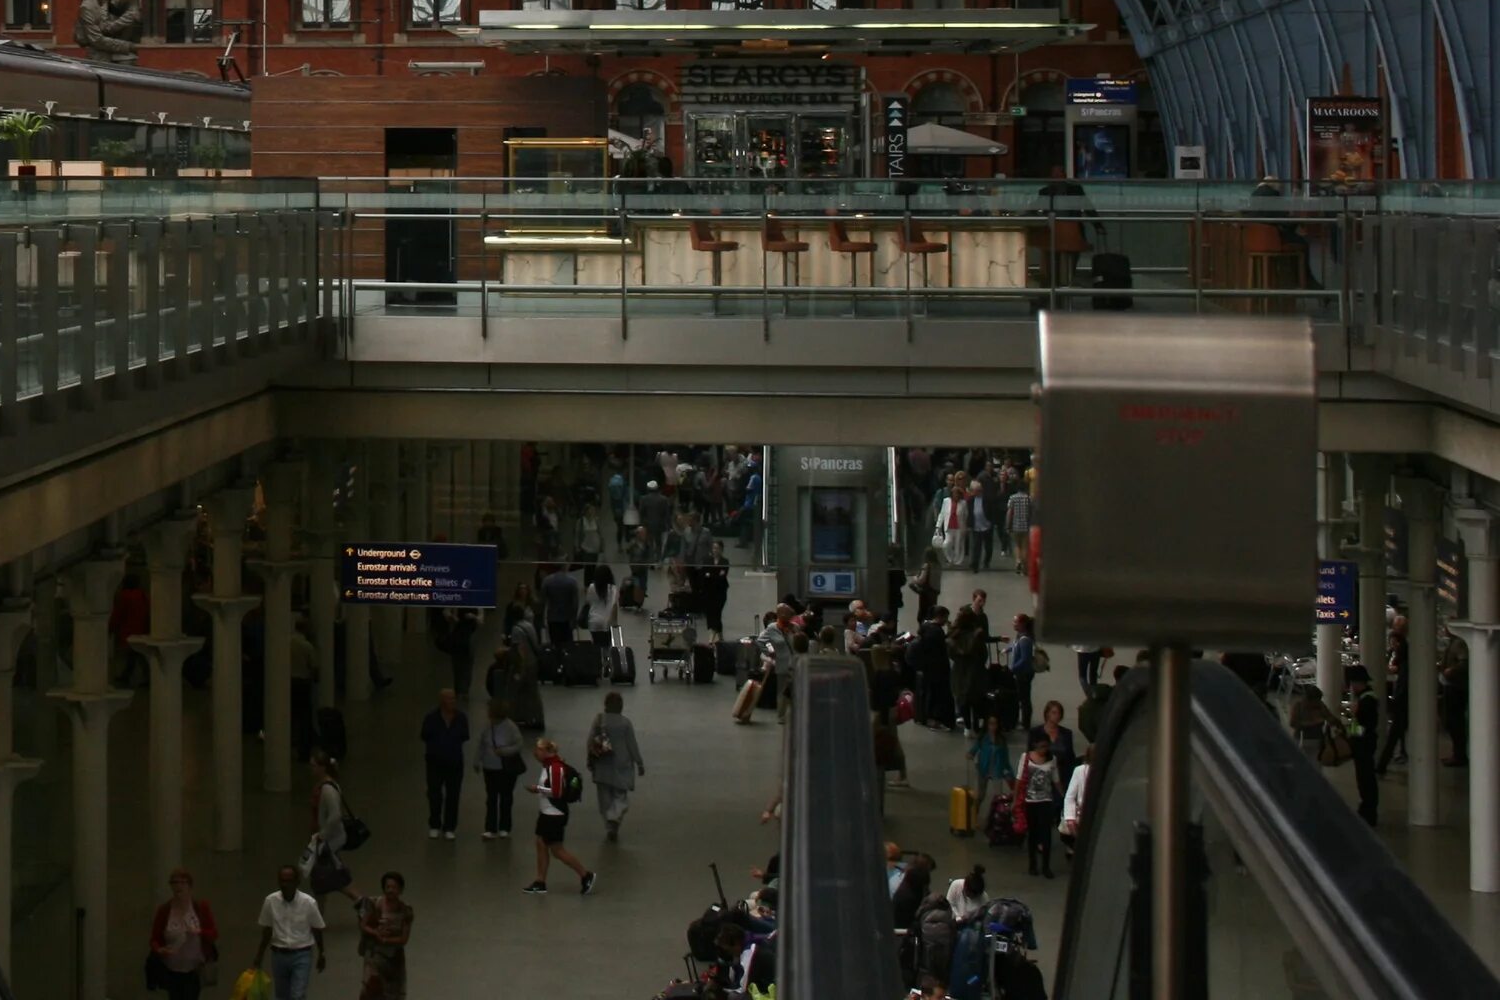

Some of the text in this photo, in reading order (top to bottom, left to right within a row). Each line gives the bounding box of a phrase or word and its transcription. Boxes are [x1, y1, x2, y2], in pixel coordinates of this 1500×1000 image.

[687, 64, 846, 87] SEARCYS
[694, 92, 841, 105] CHAMPAGNE BAR
[1312, 107, 1379, 117] MACAROONS
[888, 133, 904, 179] TAIRS
[813, 456, 864, 471] Pancras
[357, 548, 406, 559] Underground
[357, 562, 389, 571] Eurostar
[389, 563, 417, 573] arrivals
[357, 576, 389, 586] Eurostar
[389, 577, 410, 586] ticket
[411, 577, 433, 586] office
[357, 590, 389, 600] Eurostar
[389, 591, 430, 601] departures
[1316, 609, 1336, 619] Taxis
